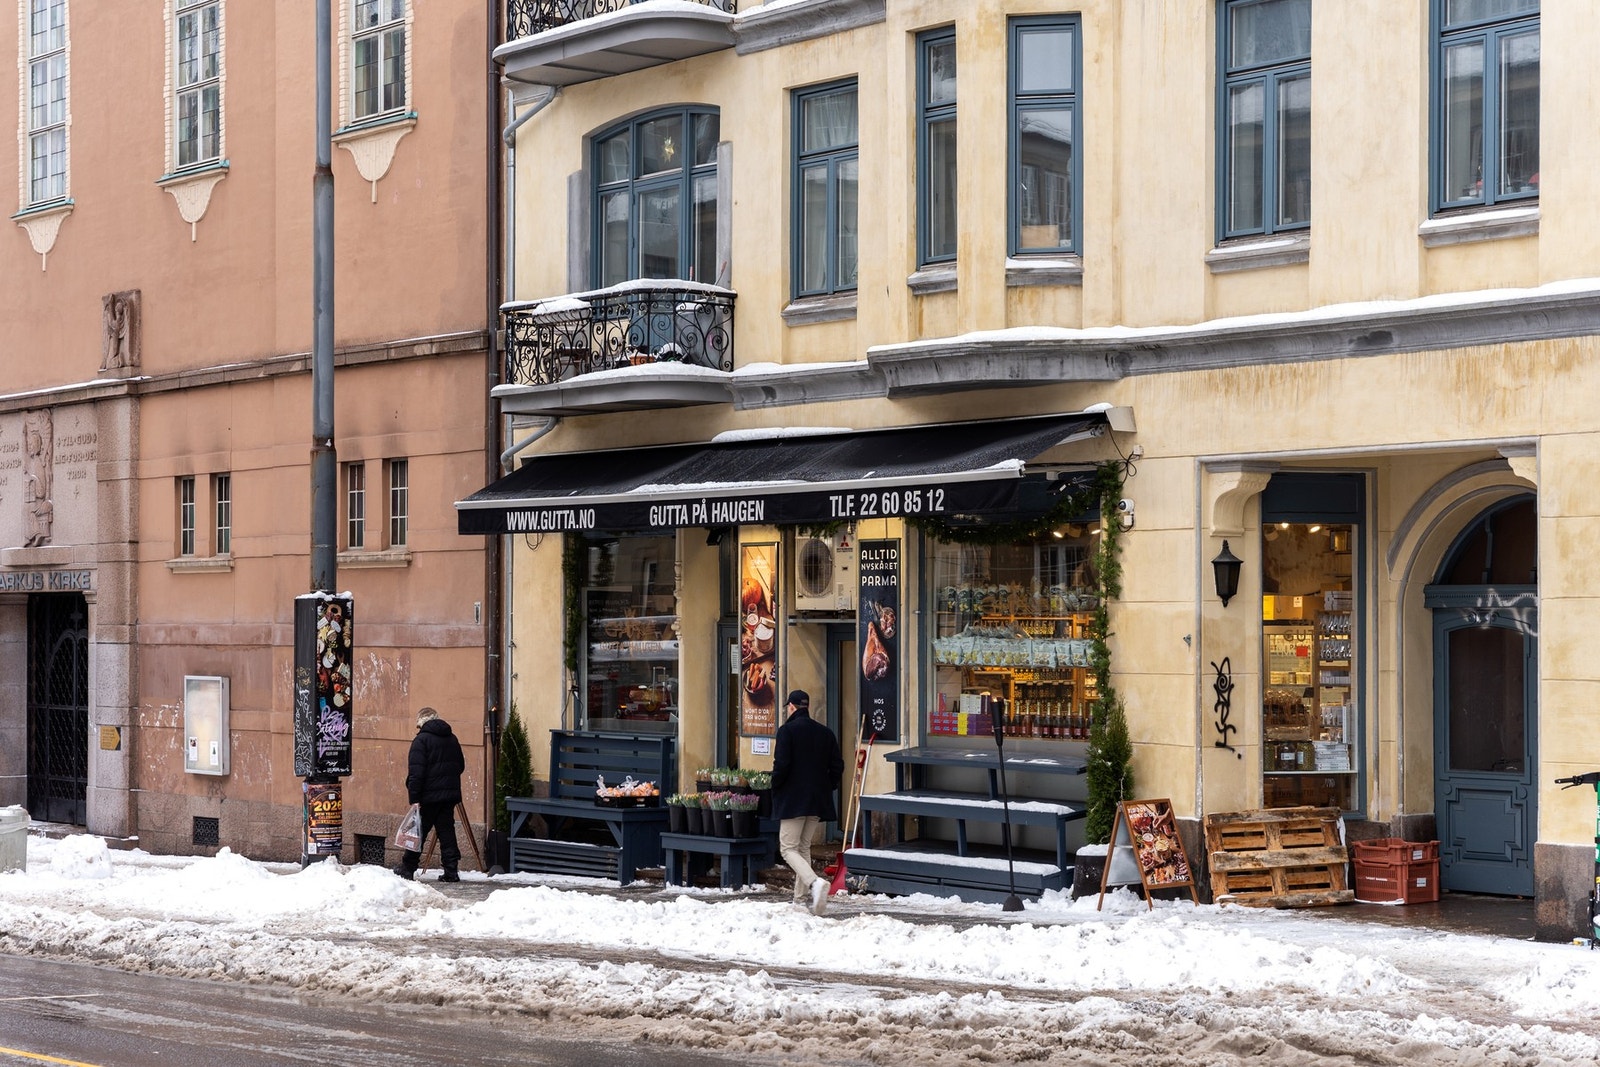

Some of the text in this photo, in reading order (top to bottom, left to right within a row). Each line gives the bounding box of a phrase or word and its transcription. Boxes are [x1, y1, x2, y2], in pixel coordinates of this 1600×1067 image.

[859, 493, 879, 516] 22
[881, 491, 900, 515] 60
[902, 490, 923, 513] 85
[926, 489, 946, 512] 12
[507, 509, 595, 531] WWW.GUTTA.NO
[650, 498, 765, 527] GUTTA PÅ HAUGEN
[861, 548, 898, 560] ALLTID
[860, 560, 898, 571] NYSKÅRET
[48, 570, 91, 590] KIRKE
[861, 574, 897, 587] PARMA
[313, 800, 342, 812] 2026
